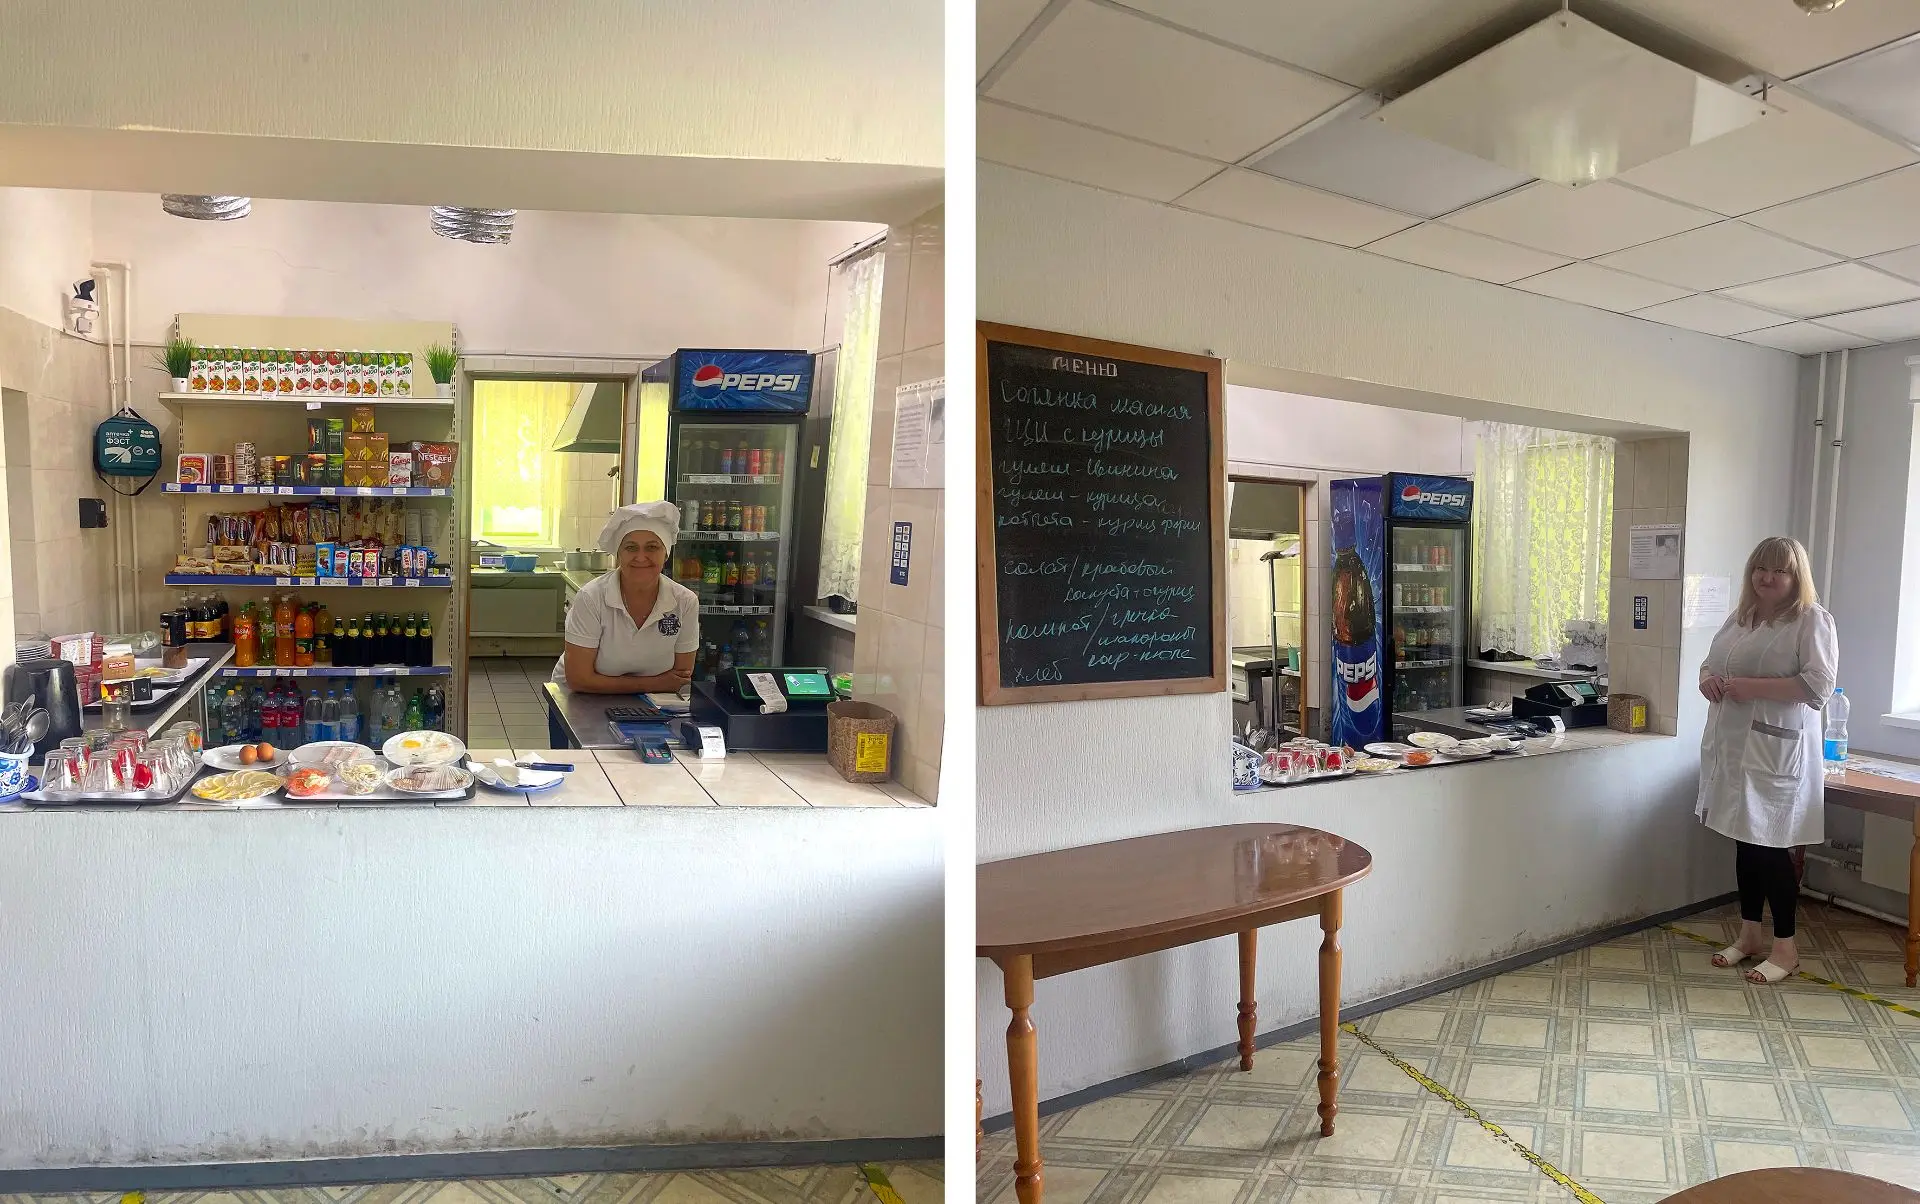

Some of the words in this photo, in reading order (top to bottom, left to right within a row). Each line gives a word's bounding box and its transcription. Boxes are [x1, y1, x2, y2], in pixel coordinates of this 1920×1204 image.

[1052, 356, 1118, 377] МЕНЮ
[718, 373, 803, 393] PEPSI
[1418, 491, 1468, 508] PEPSI
[1014, 657, 1068, 683] хлеб
[1336, 651, 1378, 682] PEPSI
